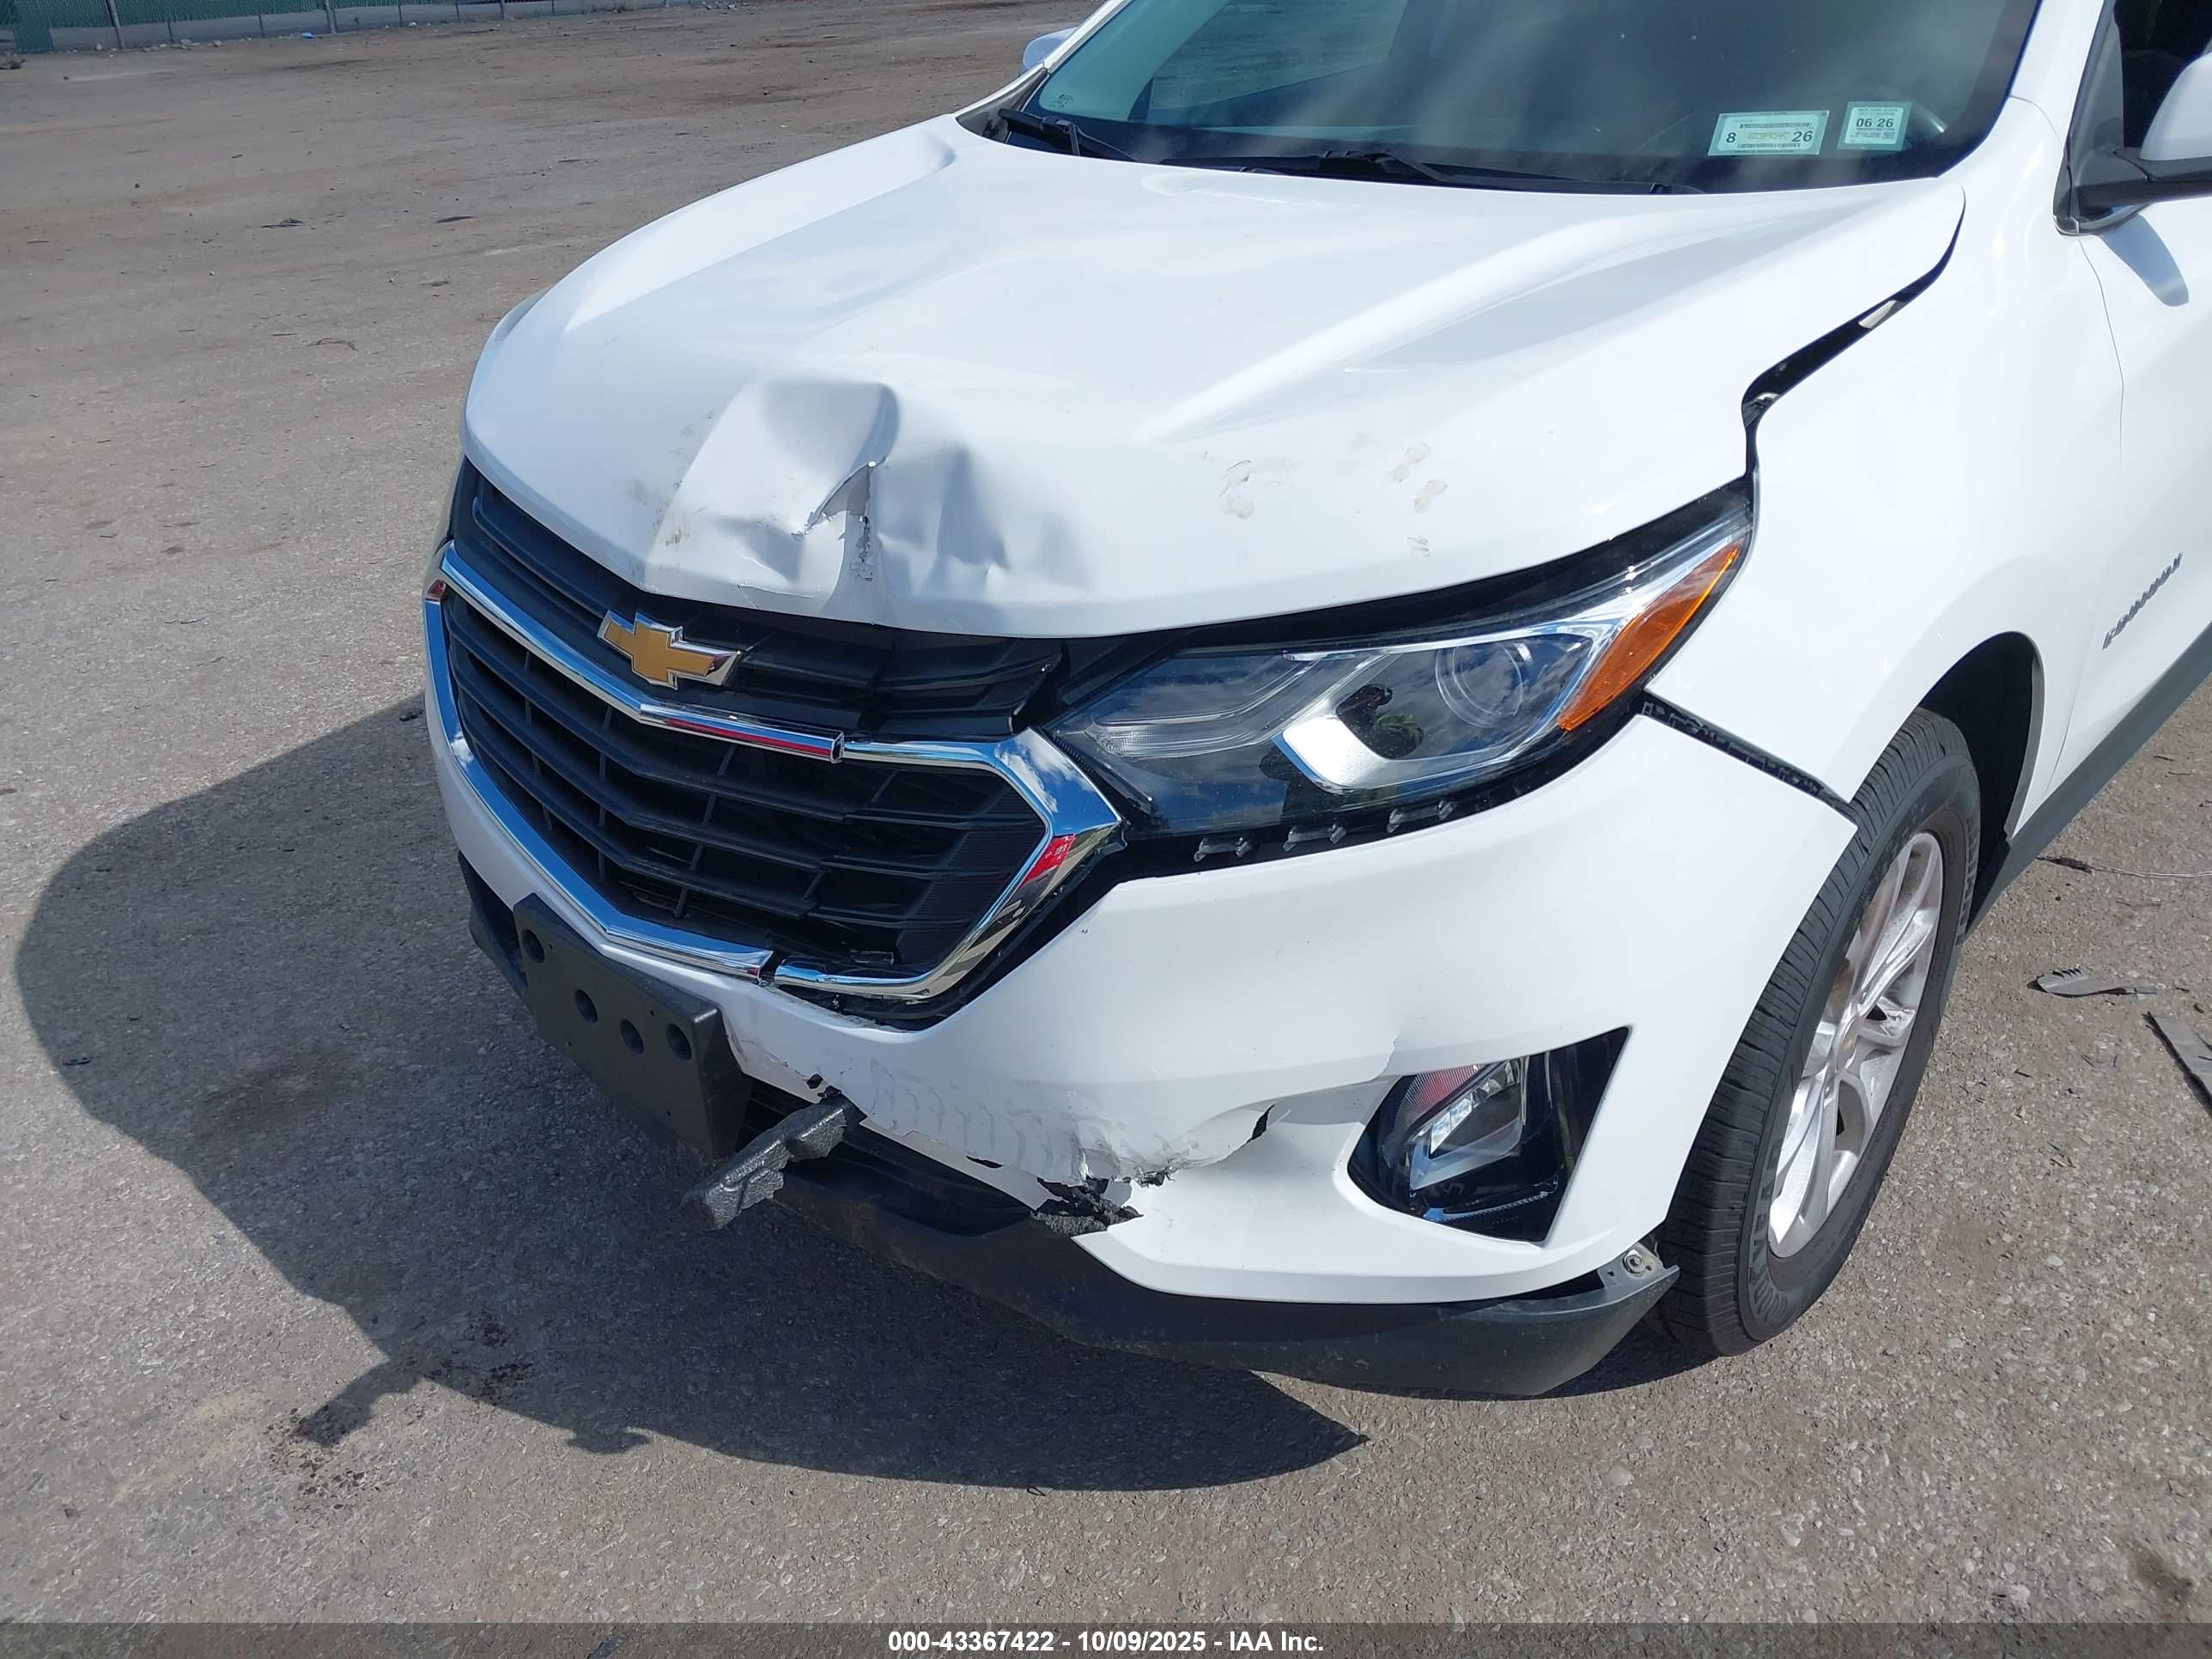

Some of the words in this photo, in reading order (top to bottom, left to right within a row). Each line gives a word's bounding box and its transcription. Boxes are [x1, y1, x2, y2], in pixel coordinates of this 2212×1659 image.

[1856, 118, 1873, 128] 06
[1876, 118, 1894, 128] 26
[1726, 131, 1737, 143] 8
[1791, 131, 1814, 143] 26
